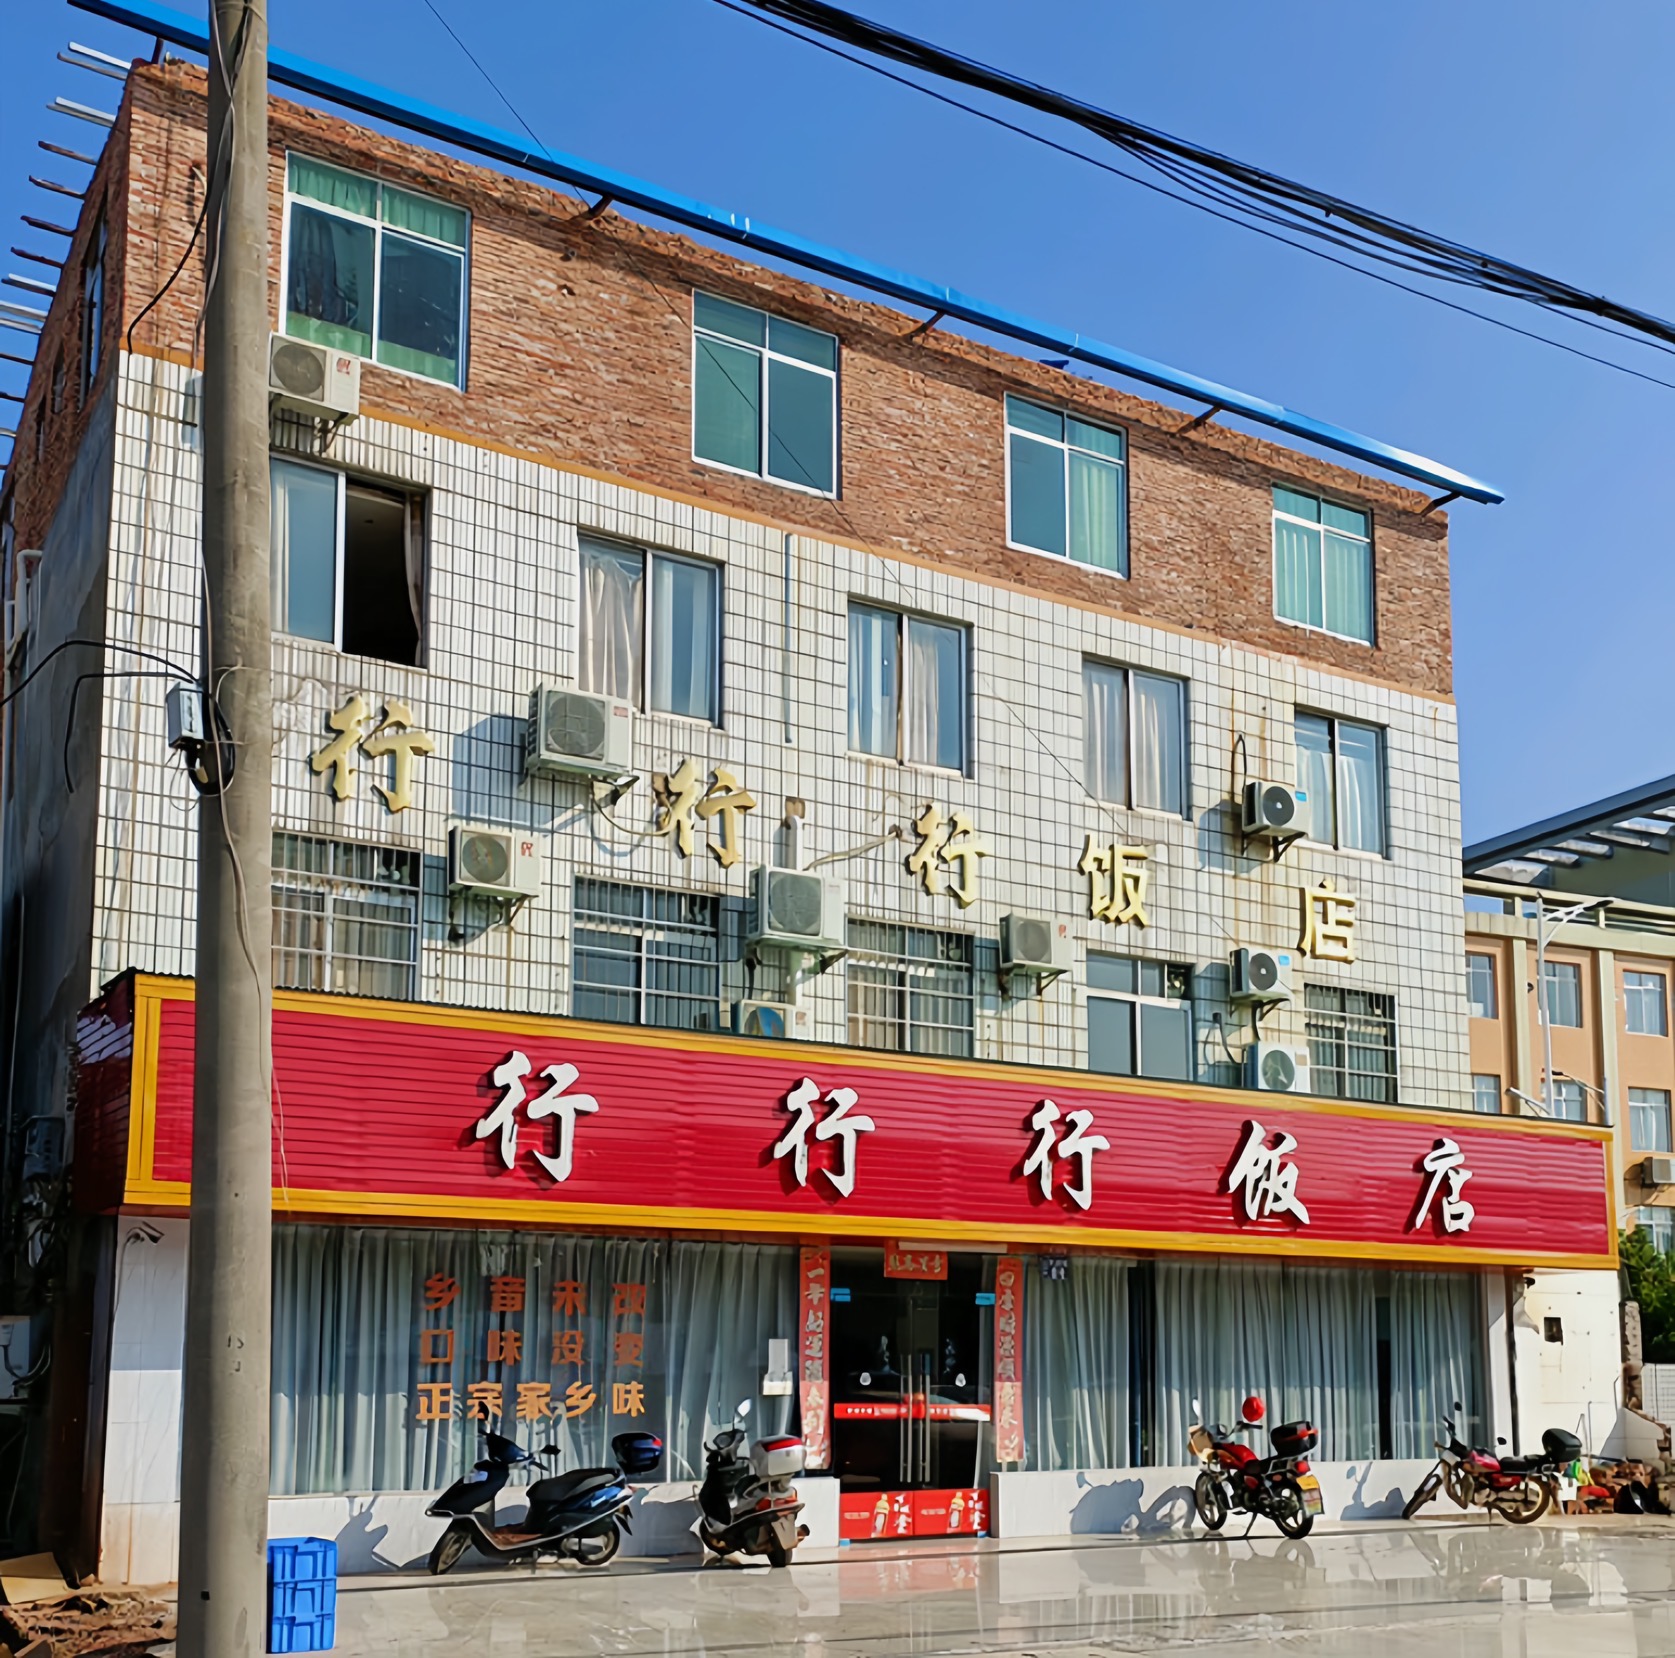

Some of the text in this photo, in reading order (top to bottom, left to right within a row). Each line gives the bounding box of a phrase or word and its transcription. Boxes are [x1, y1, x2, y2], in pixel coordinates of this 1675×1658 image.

[311, 692, 1357, 963] 行行行饭店
[476, 1050, 1476, 1233] 行行行饭店
[415, 1380, 645, 1420] 正宗家乡味
